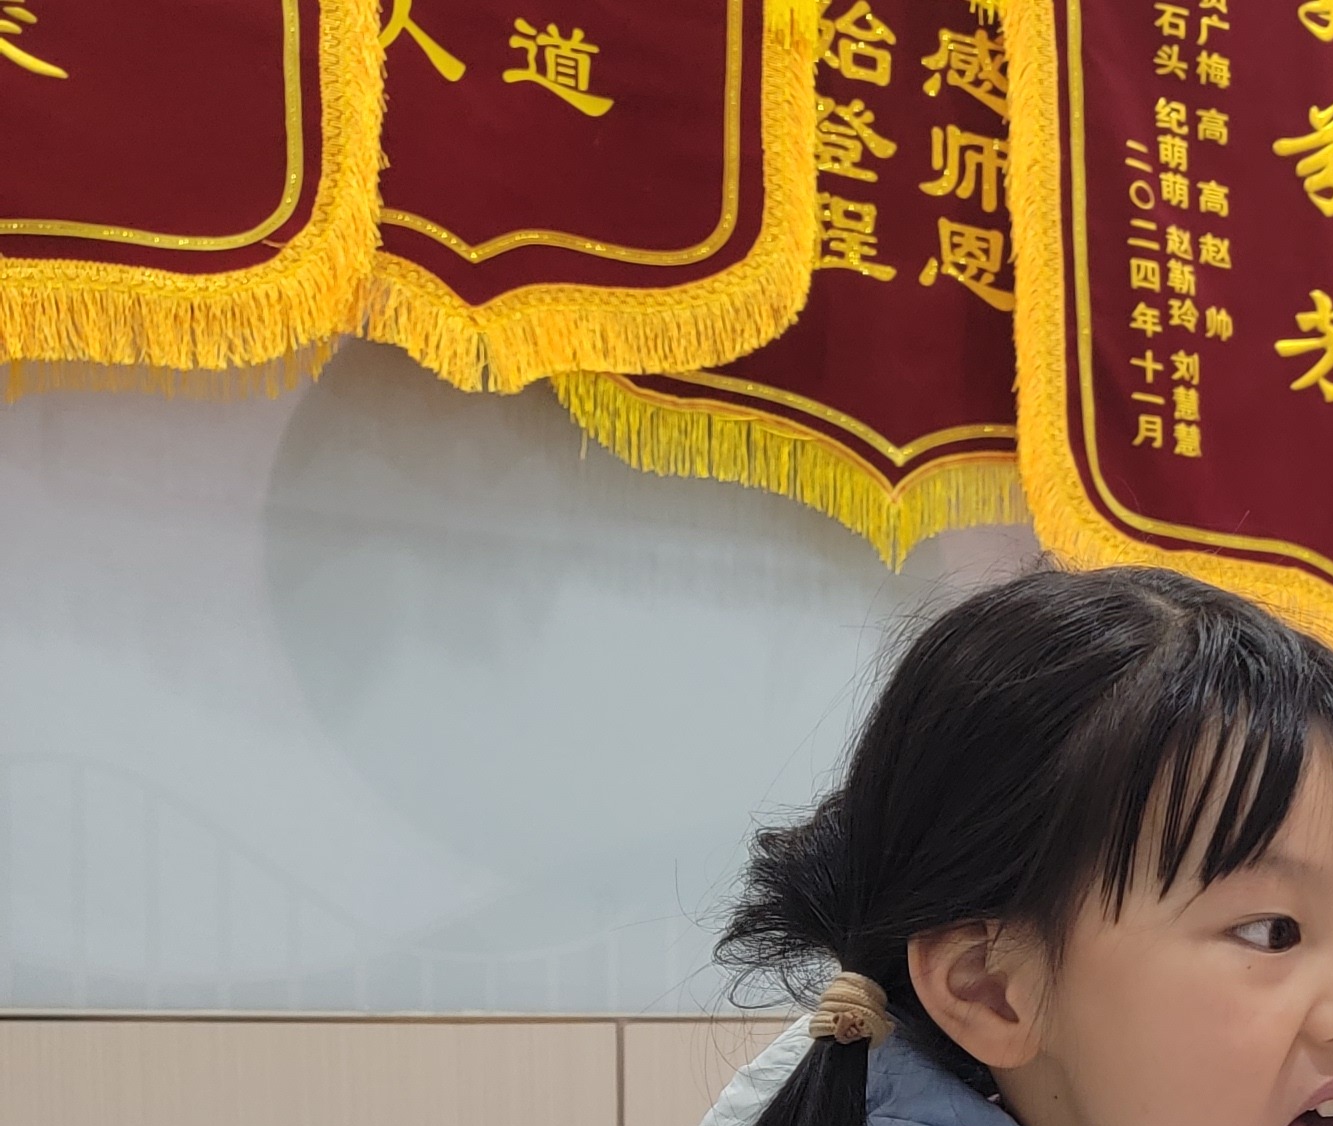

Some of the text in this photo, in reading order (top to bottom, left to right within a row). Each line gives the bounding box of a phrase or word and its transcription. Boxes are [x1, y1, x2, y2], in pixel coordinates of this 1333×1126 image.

[502, 17, 614, 117] 道
[918, 28, 1017, 312] 感师恩
